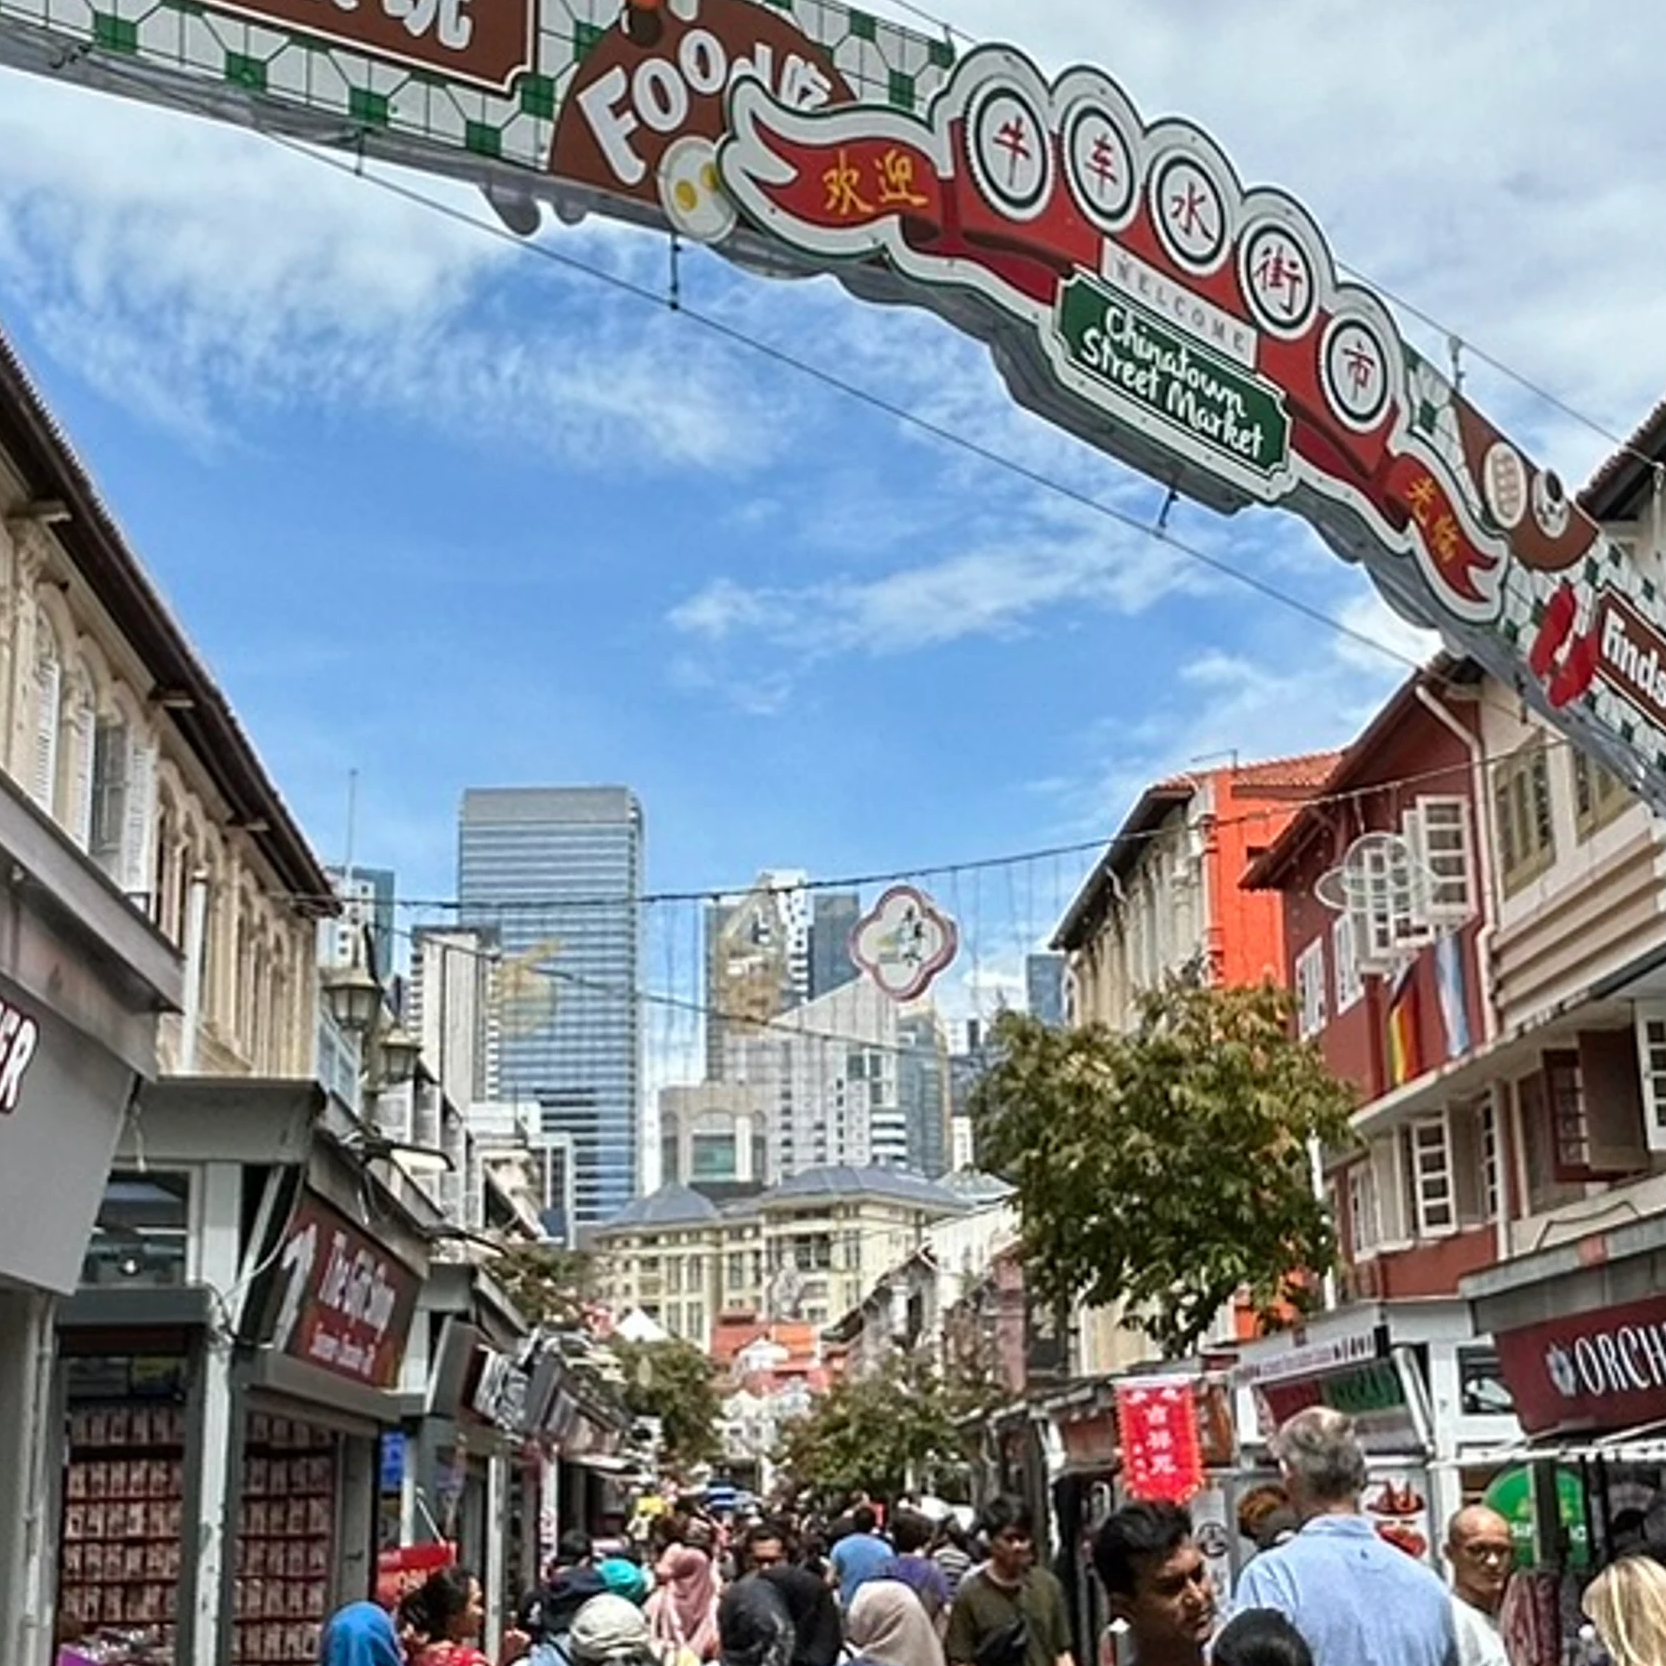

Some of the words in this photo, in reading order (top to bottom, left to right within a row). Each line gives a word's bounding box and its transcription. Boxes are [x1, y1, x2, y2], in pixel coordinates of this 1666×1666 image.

[821, 150, 930, 217] 欢迎
[1113, 248, 1247, 354] WELCOME
[1081, 325, 1162, 397] Street
[1165, 373, 1266, 459] Market
[1104, 305, 1248, 419] Chinatown
